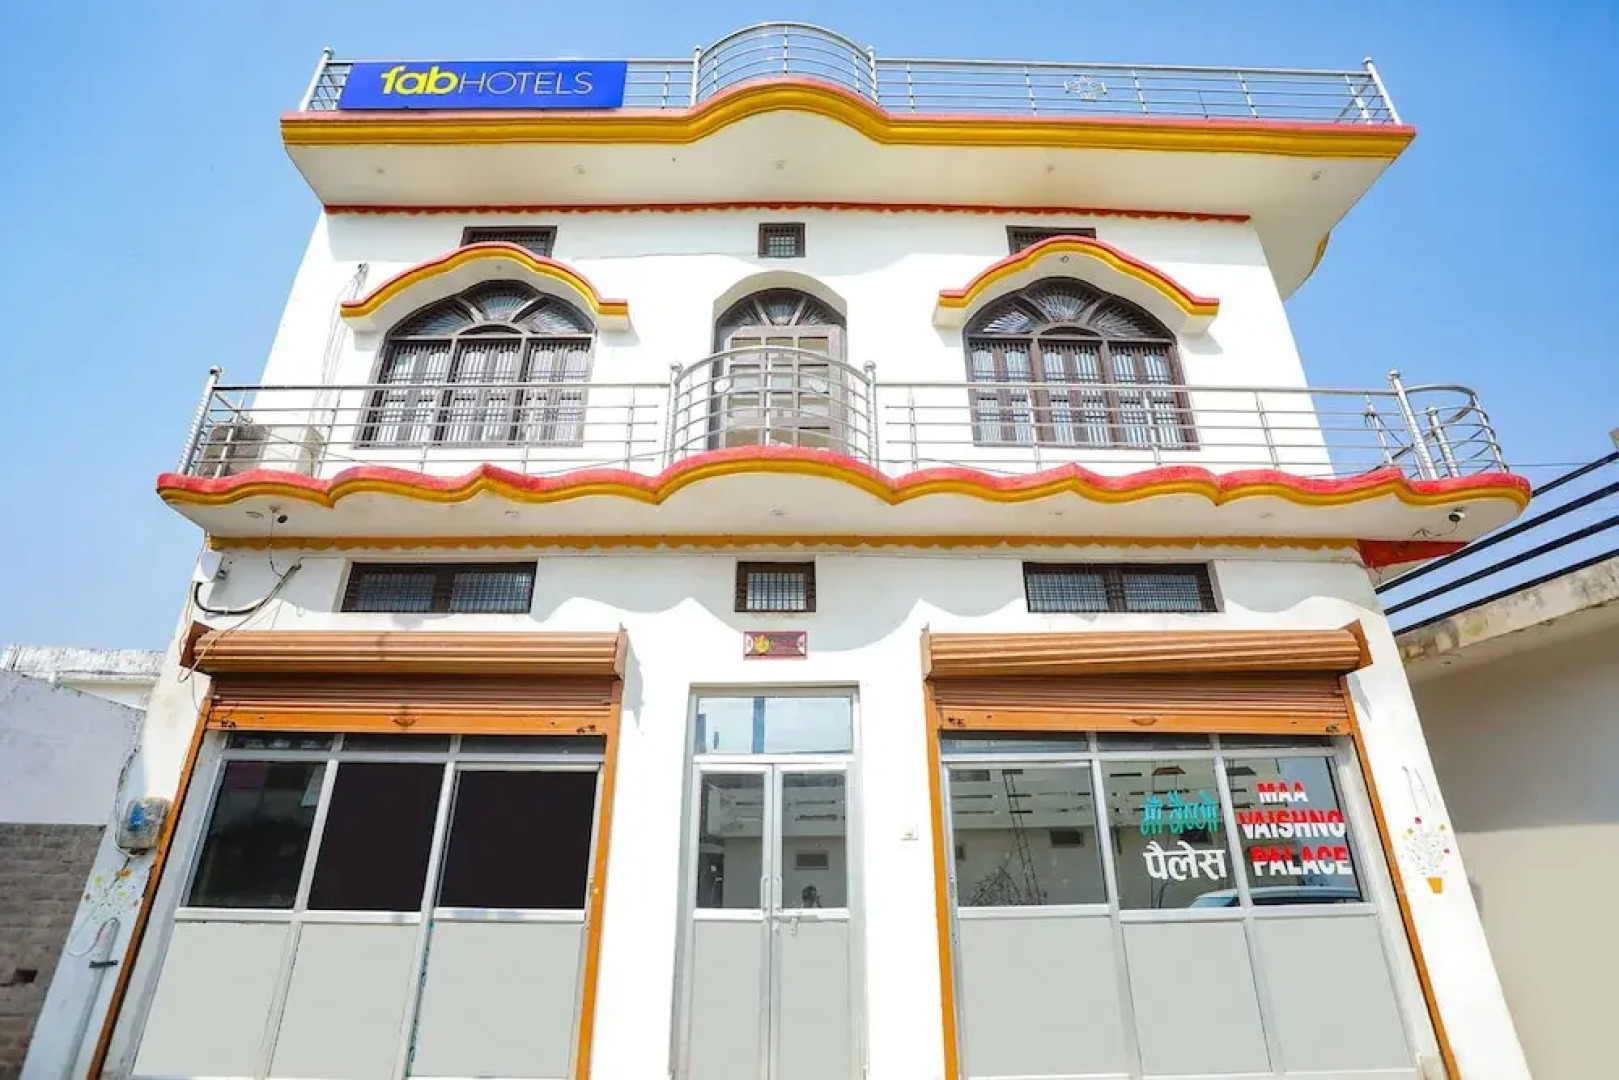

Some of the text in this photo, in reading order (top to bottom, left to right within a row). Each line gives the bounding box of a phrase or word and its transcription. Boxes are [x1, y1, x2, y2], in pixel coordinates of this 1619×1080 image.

[381, 65, 593, 95] fabHOTELS
[1257, 781, 1308, 803] MAA
[1236, 810, 1345, 839] VAISHNO
[1142, 840, 1227, 881] पैलेस
[1249, 845, 1352, 876] PALACE
